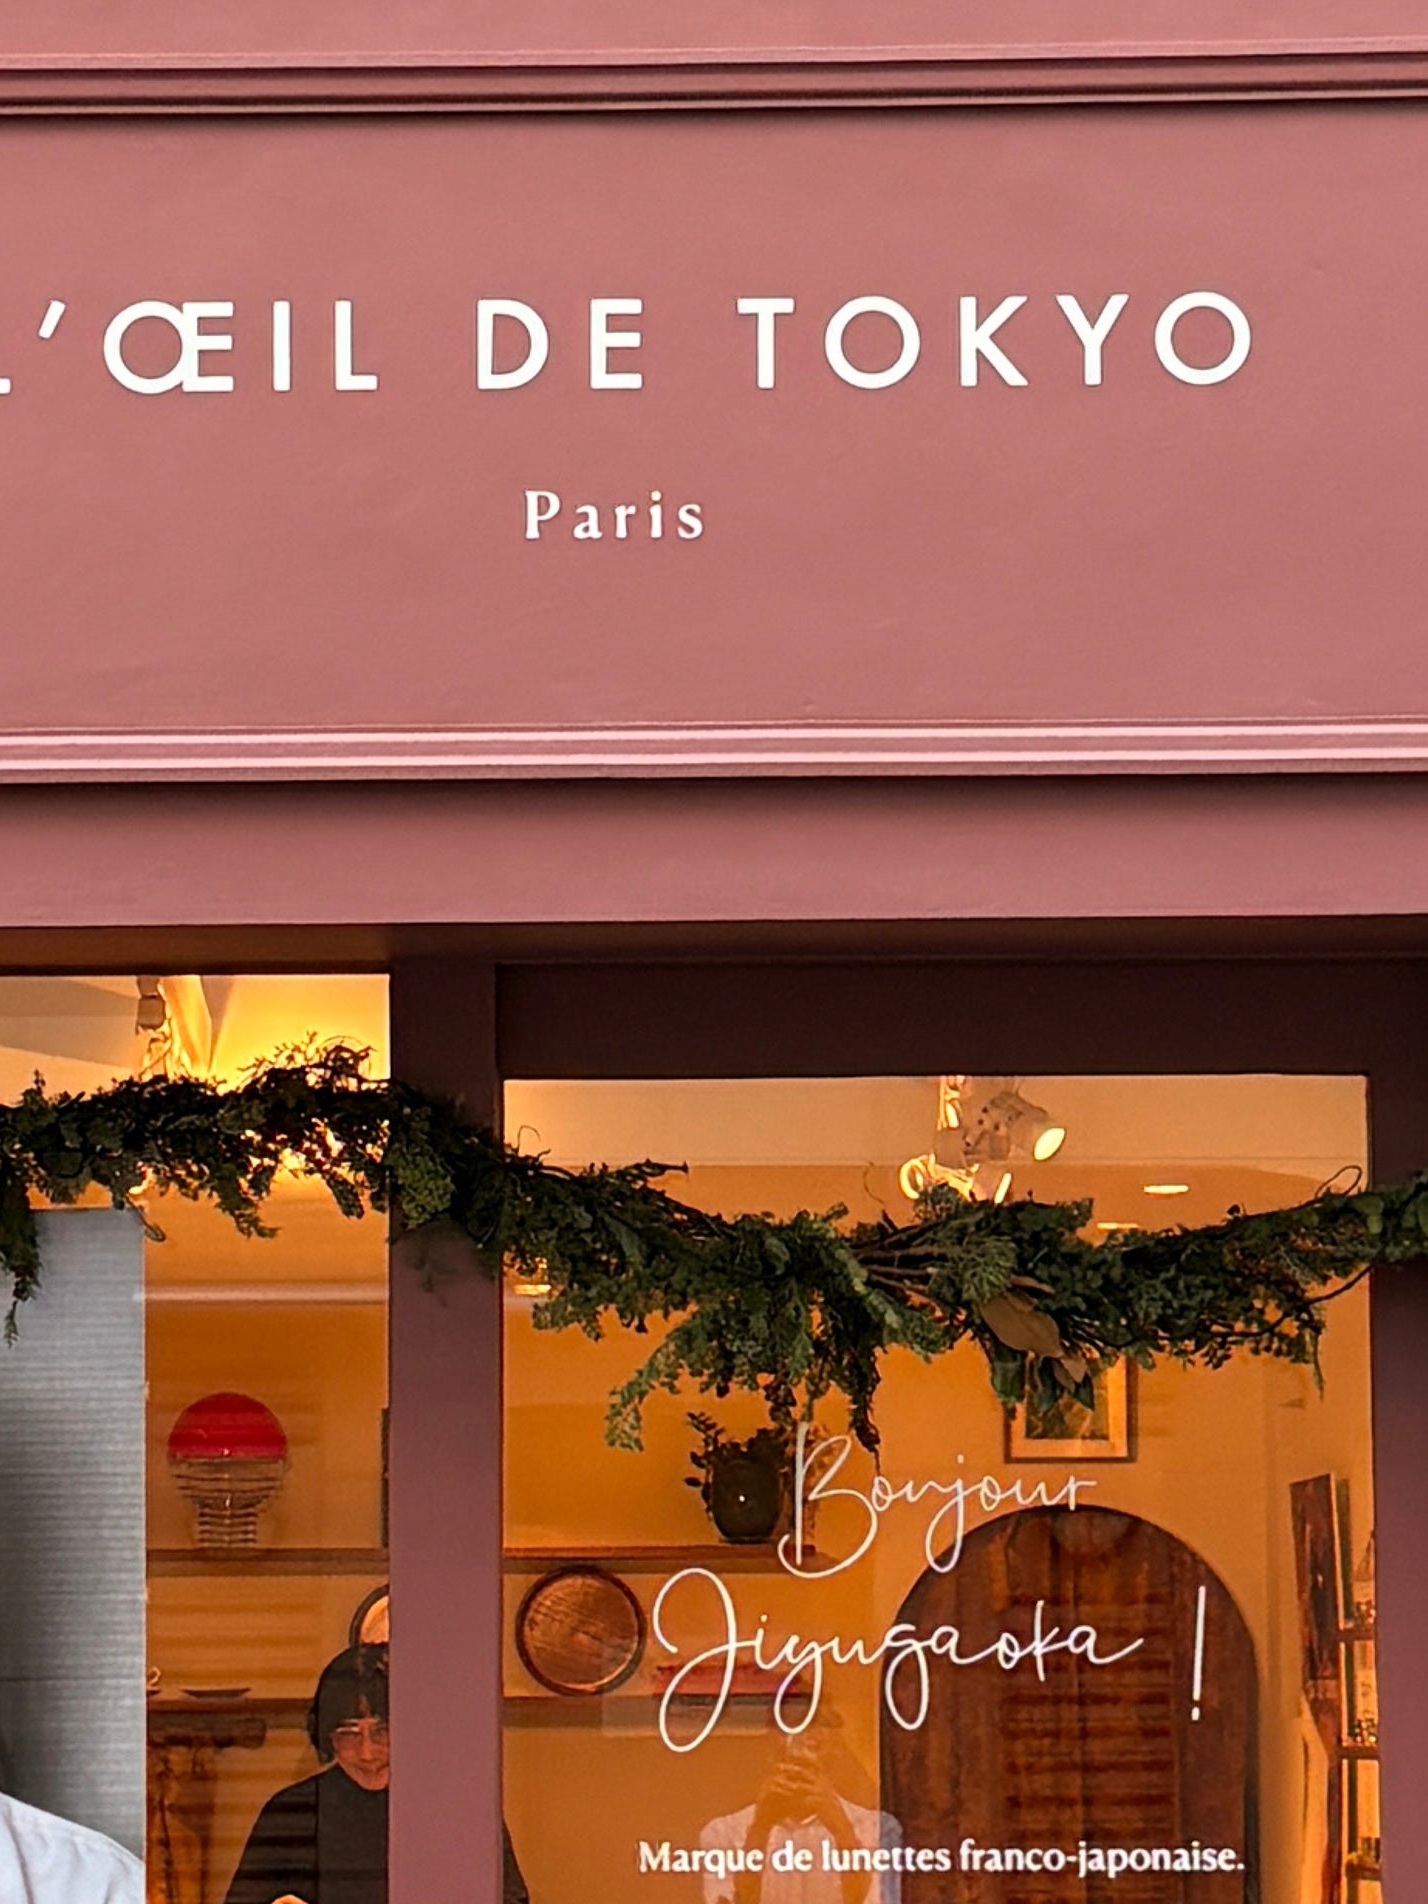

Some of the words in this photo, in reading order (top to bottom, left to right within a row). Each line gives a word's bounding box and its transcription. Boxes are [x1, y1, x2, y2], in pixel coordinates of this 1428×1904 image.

[476, 298, 642, 390] DE
[736, 291, 1252, 389] TOKYO
[524, 490, 704, 540] Paris
[778, 1420, 1097, 1579] Bonjour
[652, 1567, 1144, 1753] Jiyugaoka
[638, 1840, 764, 1880] Marque
[771, 1839, 813, 1873] de
[821, 1839, 952, 1872] lunettes
[959, 1838, 1246, 1880] franco-japonaise.
